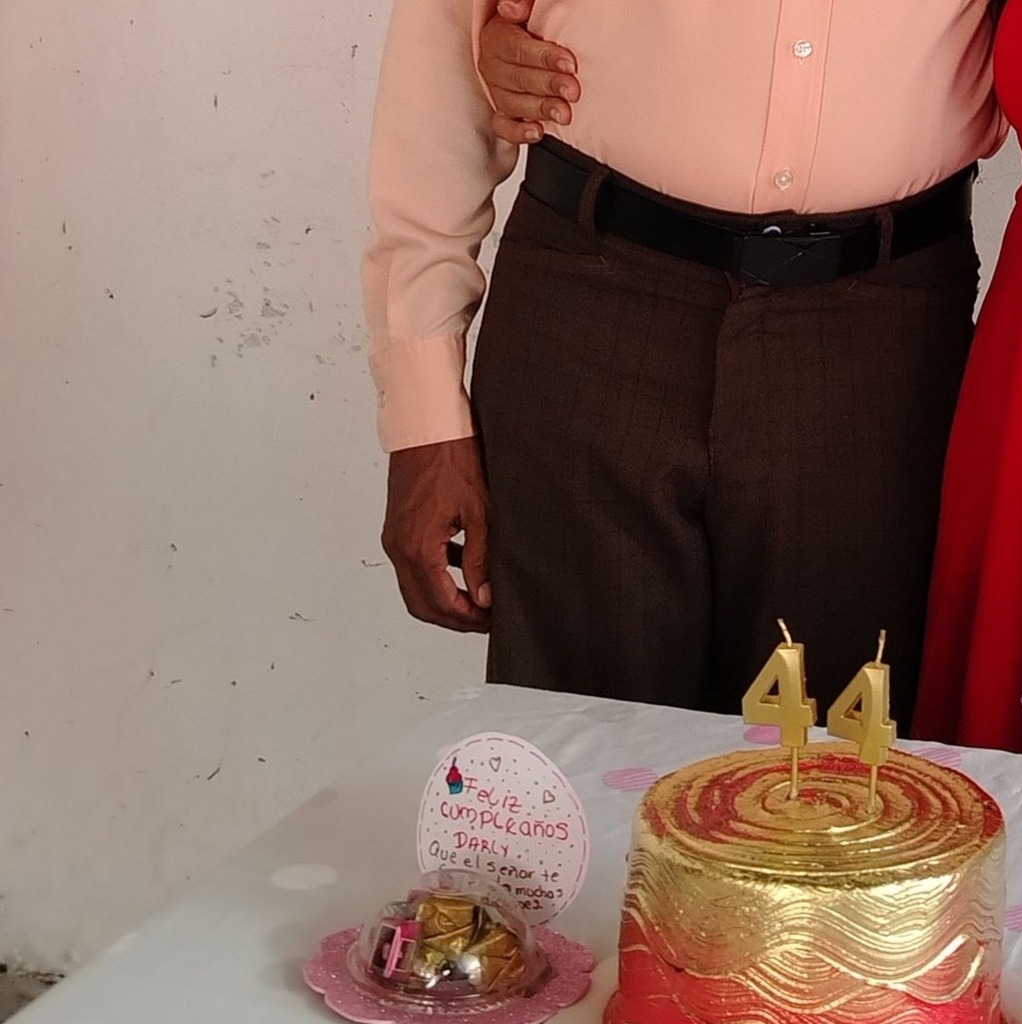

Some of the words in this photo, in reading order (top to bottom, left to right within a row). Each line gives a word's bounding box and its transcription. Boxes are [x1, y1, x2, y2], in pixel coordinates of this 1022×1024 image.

[429, 840, 457, 864] Que
[463, 854, 480, 869] el
[541, 869, 560, 883] te
[453, 830, 510, 858] DARLY
